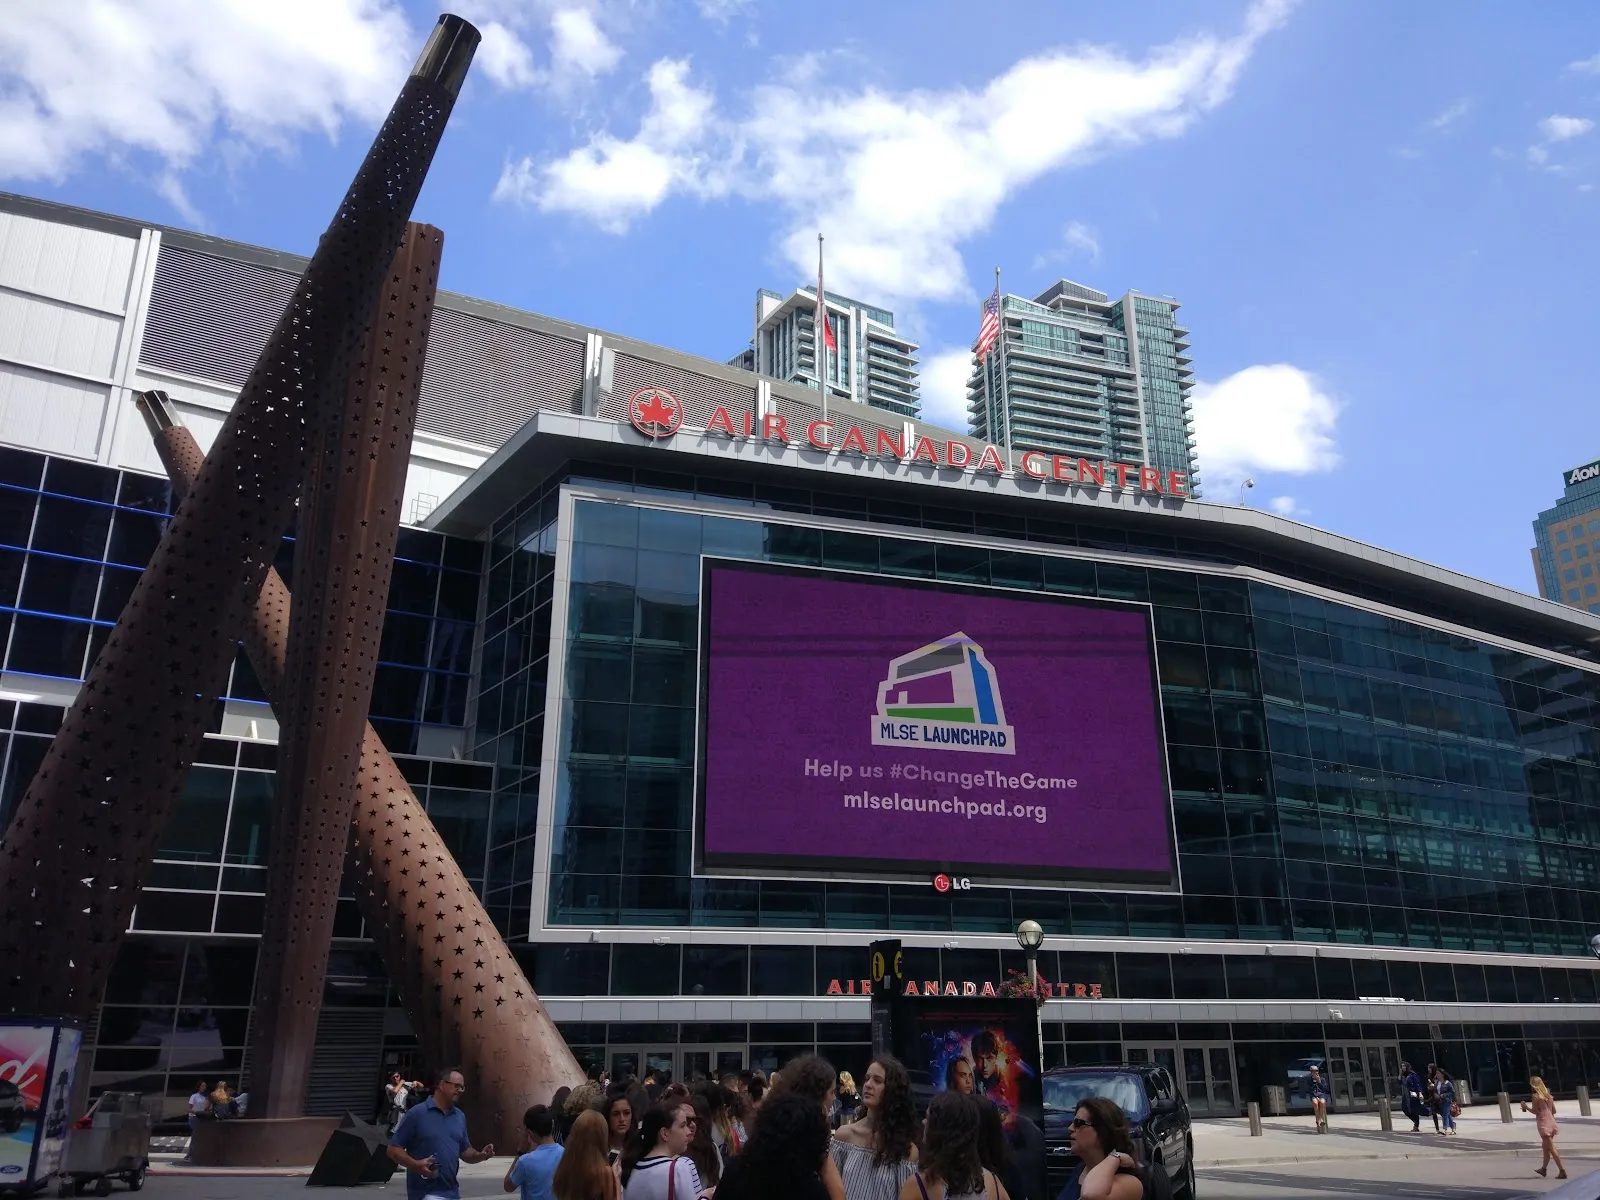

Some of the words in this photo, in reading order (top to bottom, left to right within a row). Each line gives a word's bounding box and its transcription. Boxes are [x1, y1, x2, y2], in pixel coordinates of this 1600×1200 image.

[706, 406, 790, 443] AIR
[806, 420, 1005, 472] CANADA
[1021, 450, 1189, 496] CENTRE
[1569, 464, 1599, 485] AON
[880, 722, 919, 741] MLSE
[923, 725, 1007, 748] LAUNCHPAD
[804, 758, 853, 782] Help
[859, 766, 884, 779] us
[890, 763, 1078, 790] #ChangeTheGame
[844, 792, 1047, 823] mlselaunchpad.org
[952, 877, 971, 890] LG
[827, 979, 872, 995] AIR
[905, 980, 997, 997] ANADA
